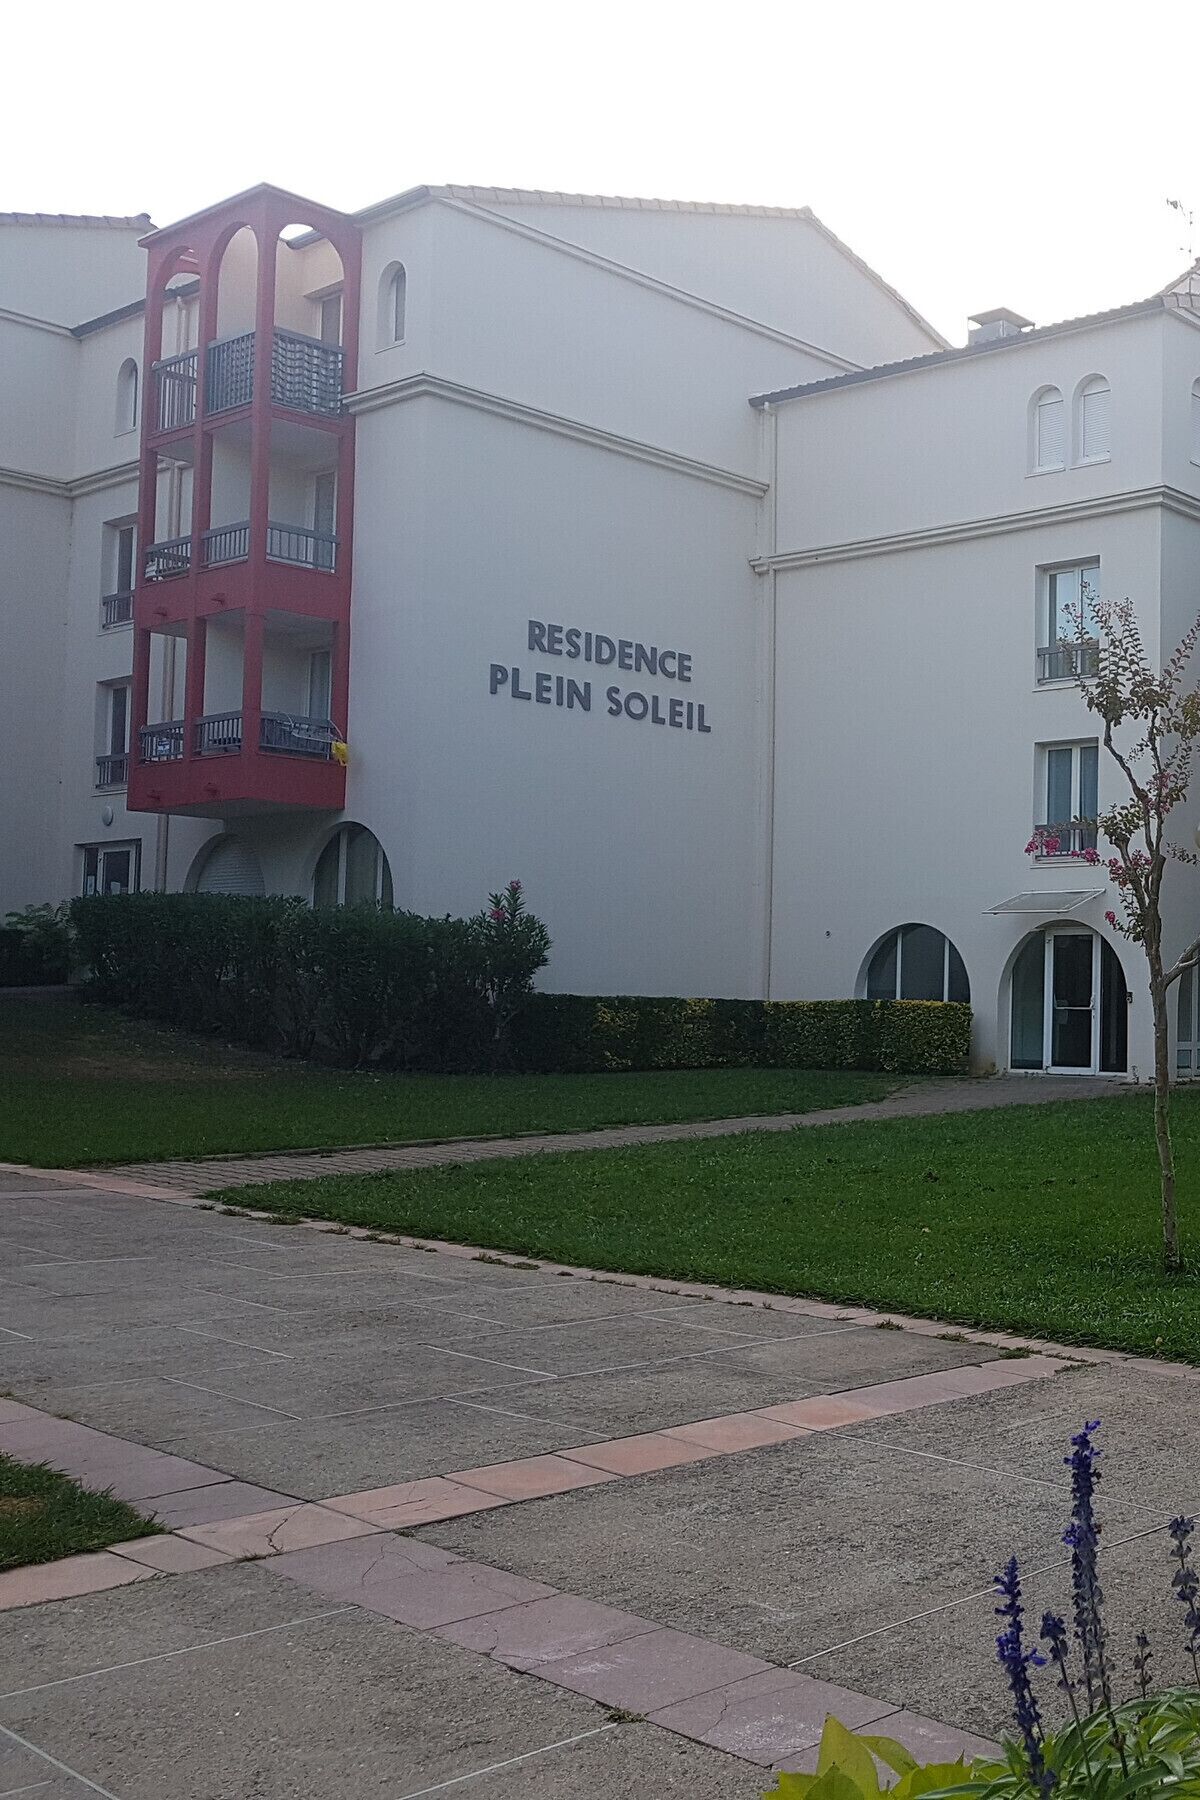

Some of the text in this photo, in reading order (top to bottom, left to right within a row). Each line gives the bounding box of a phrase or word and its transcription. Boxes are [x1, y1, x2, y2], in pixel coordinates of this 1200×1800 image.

[528, 619, 692, 682] RESIDENCE
[489, 663, 711, 733] PLEIN SOLEIL
